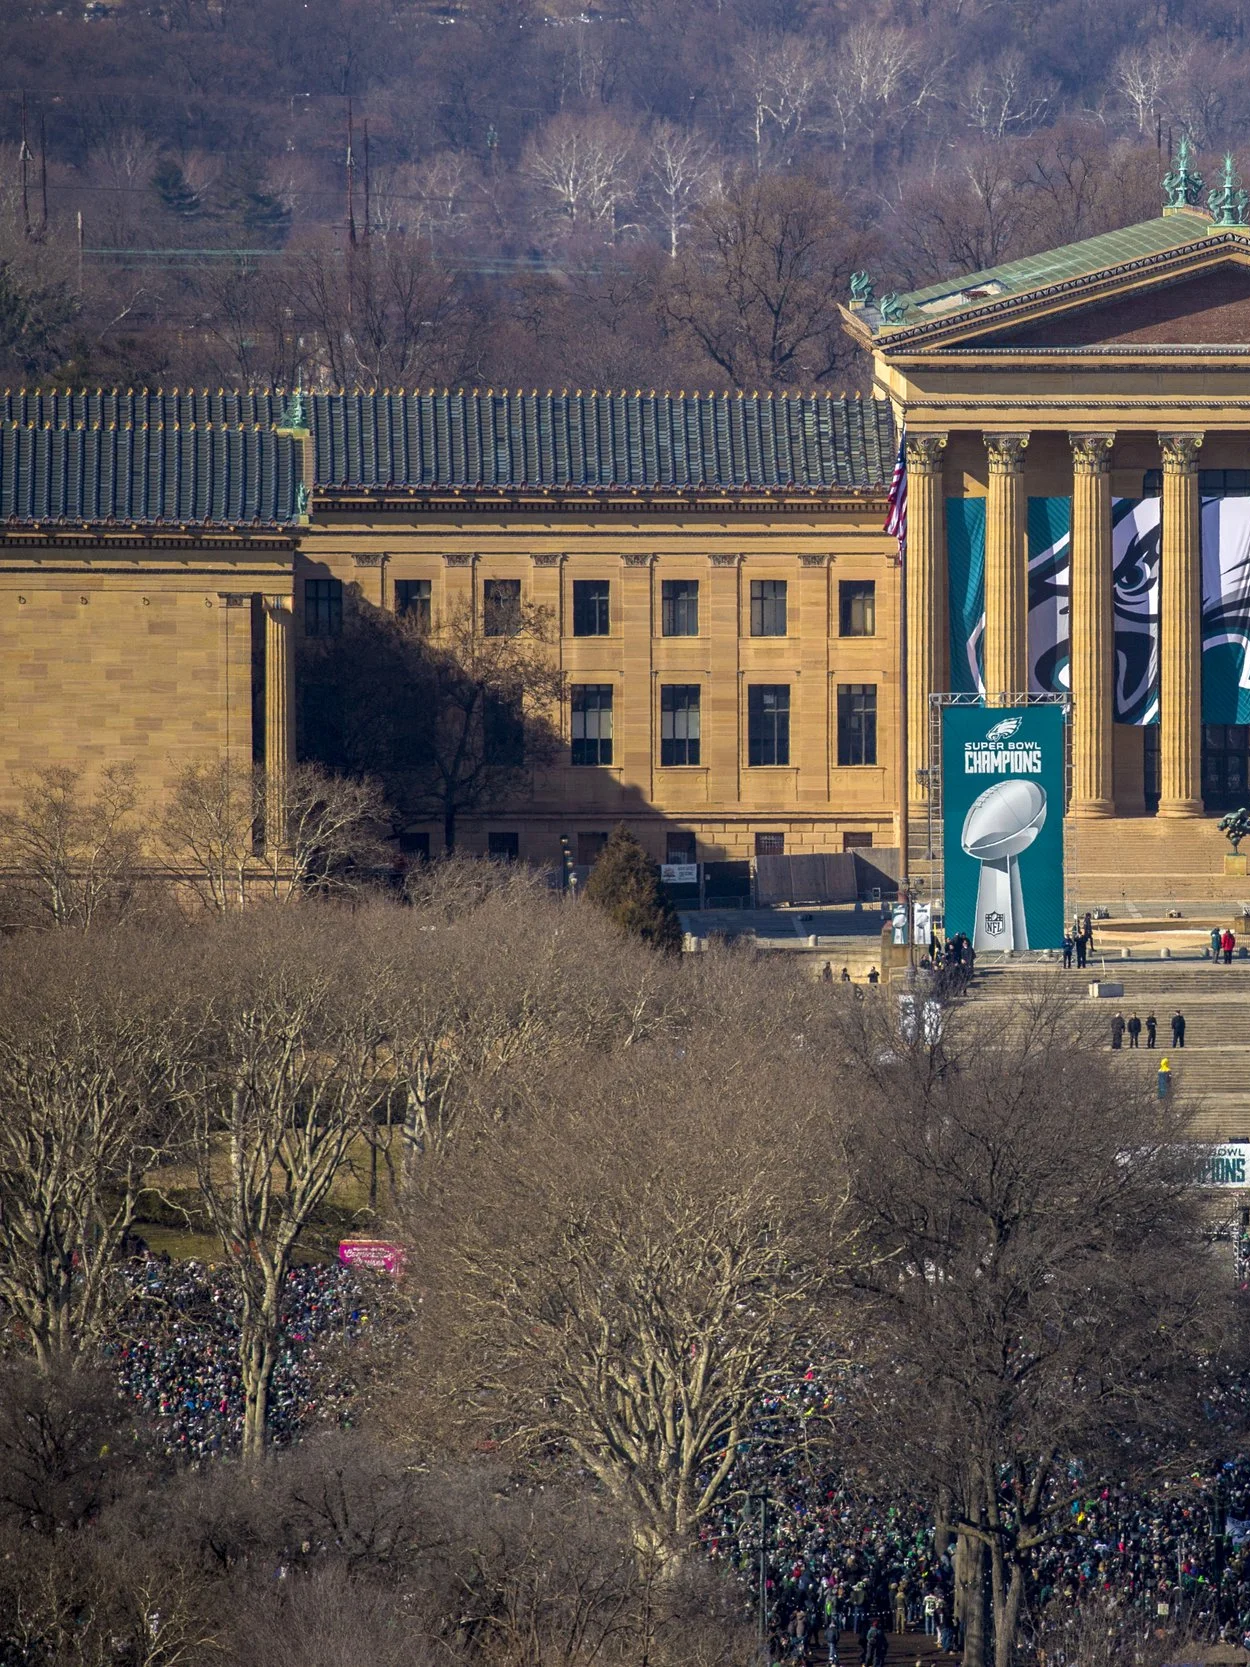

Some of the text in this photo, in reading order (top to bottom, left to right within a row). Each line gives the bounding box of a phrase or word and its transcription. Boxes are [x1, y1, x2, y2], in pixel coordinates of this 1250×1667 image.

[965, 742, 1004, 750] SUPER
[965, 751, 1041, 773] CHAMPIONS
[986, 922, 1001, 933] NFL
